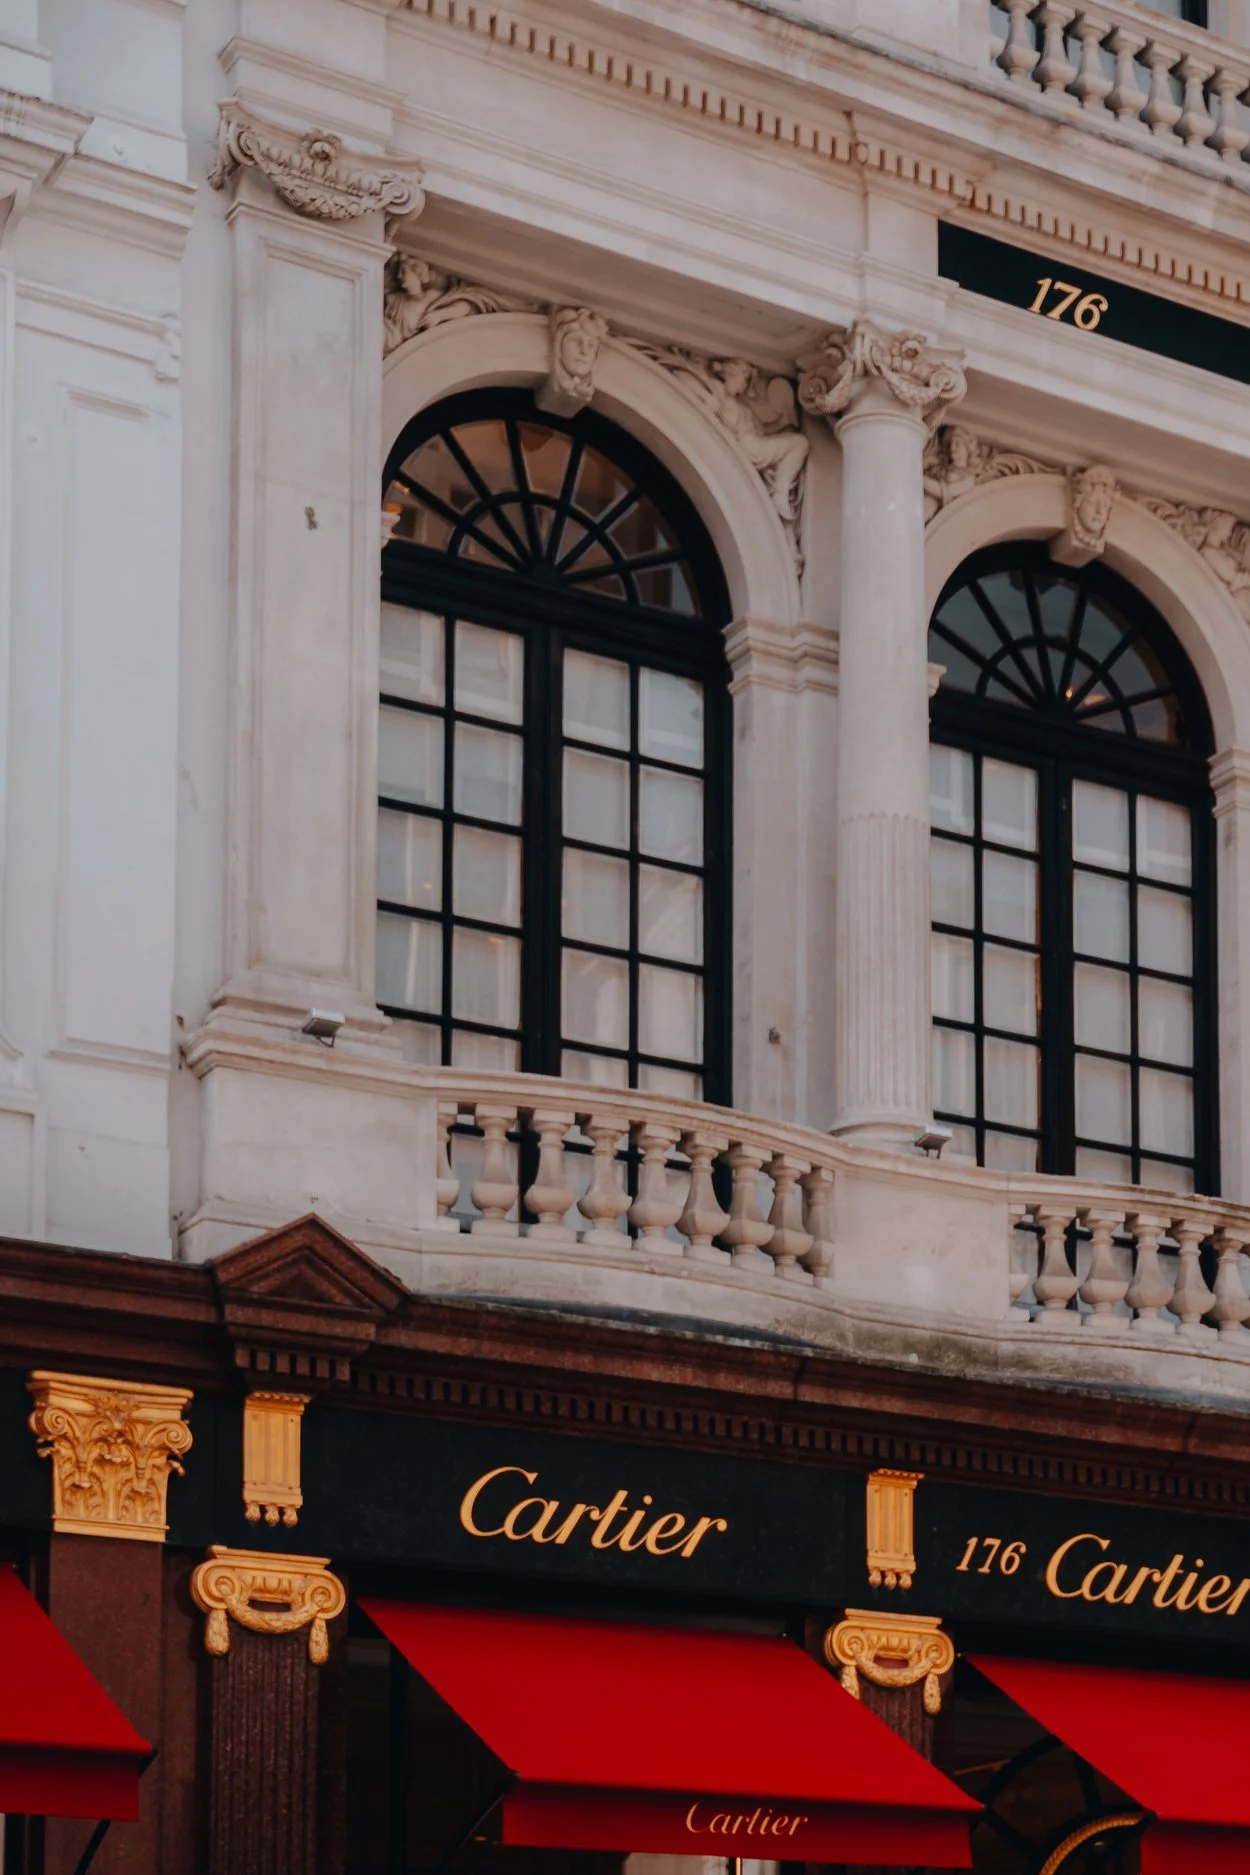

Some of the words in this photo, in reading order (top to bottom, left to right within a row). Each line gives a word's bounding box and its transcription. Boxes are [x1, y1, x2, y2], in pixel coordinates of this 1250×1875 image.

[1026, 277, 1109, 331] 176
[459, 1466, 728, 1558] Cartier
[955, 1536, 1027, 1576] 176
[685, 1802, 809, 1836] Cartier
